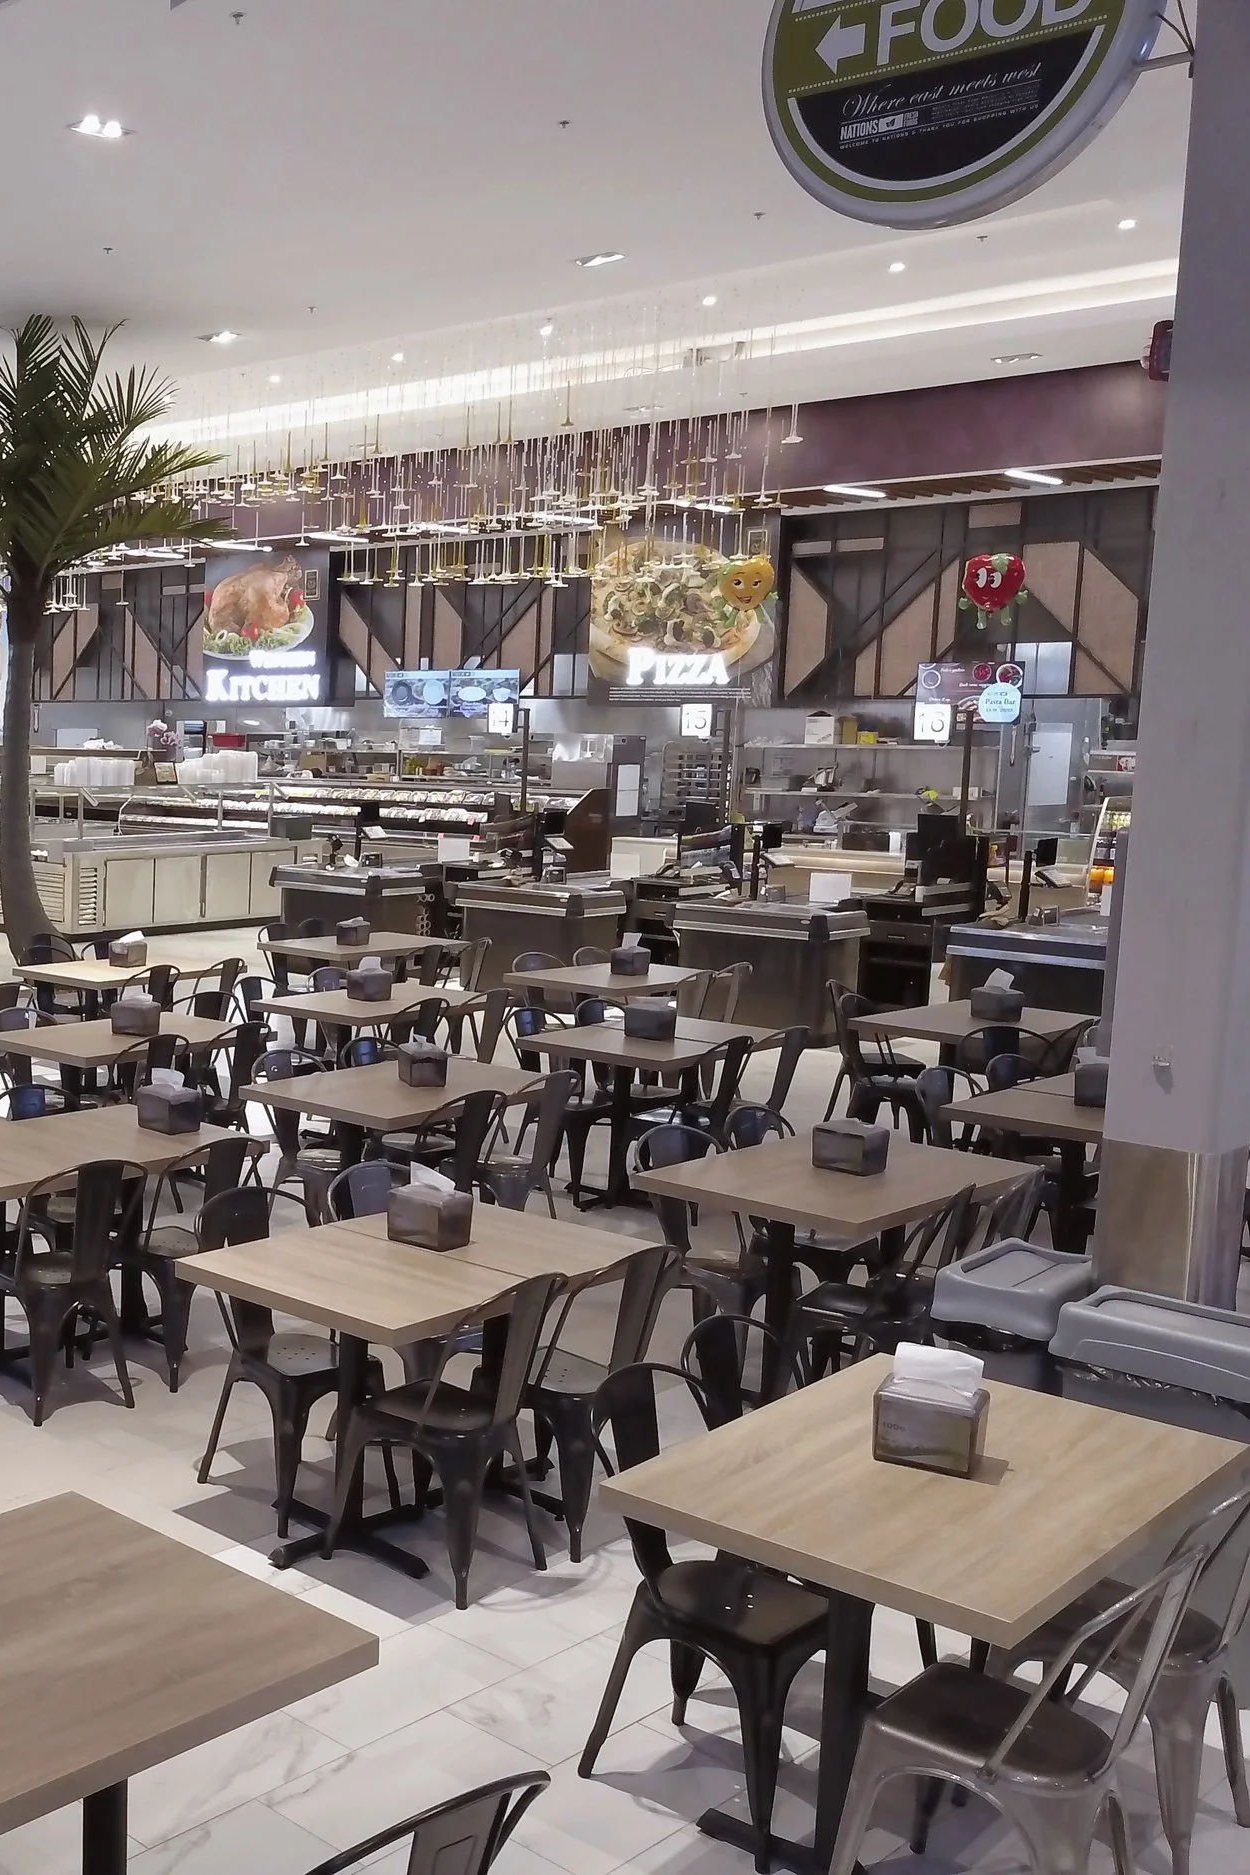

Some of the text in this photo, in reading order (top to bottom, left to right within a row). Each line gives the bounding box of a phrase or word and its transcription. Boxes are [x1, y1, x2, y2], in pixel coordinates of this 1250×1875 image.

[842, 84, 906, 118] Where
[908, 85, 944, 105] east
[949, 73, 999, 97] meets
[1002, 62, 1042, 85] west
[840, 119, 880, 141] NATIONS
[625, 647, 731, 686] PIZZA
[205, 669, 321, 701] KITCHEN
[685, 710, 708, 731] 15
[918, 710, 945, 734] 16
